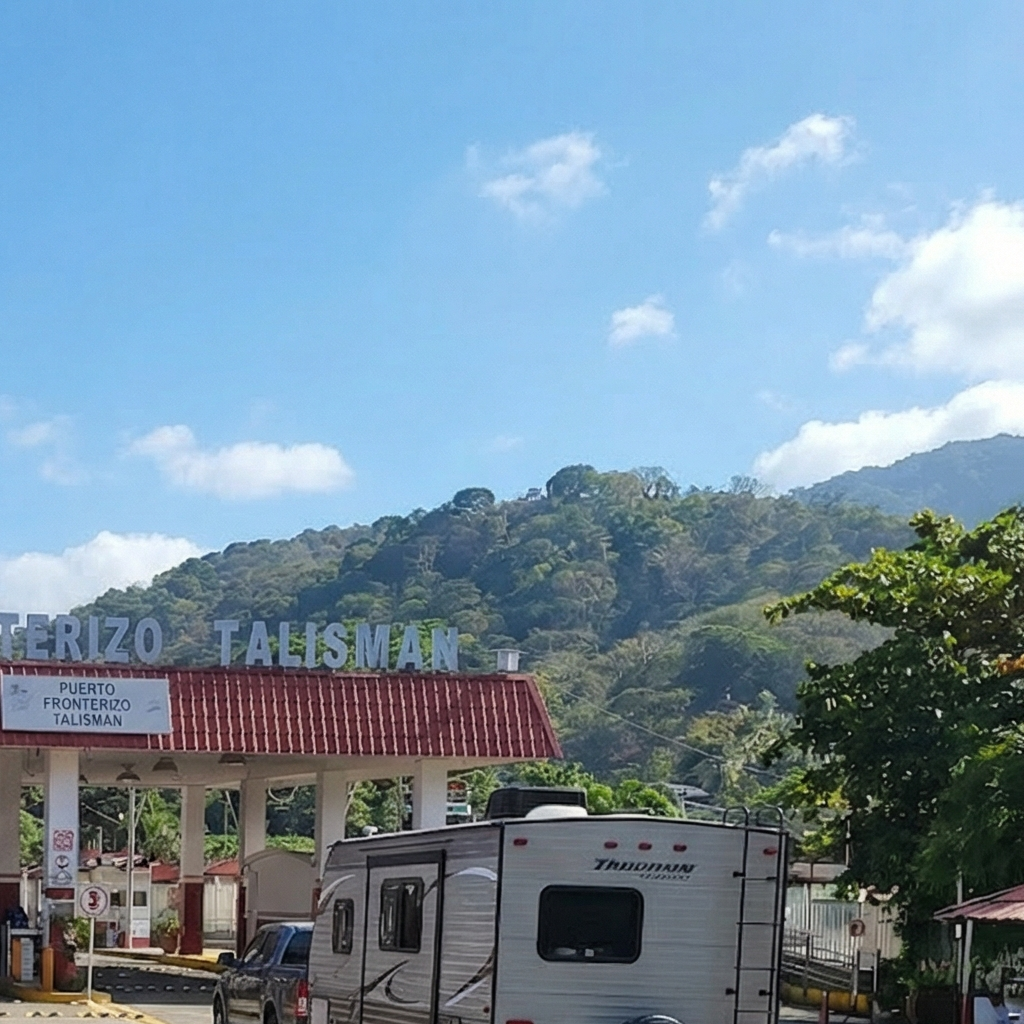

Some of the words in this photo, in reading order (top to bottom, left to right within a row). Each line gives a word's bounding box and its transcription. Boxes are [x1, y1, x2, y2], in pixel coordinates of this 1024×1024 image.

[214, 620, 458, 670] TALISMAN
[59, 682, 115, 695] PUERTO
[44, 698, 131, 711] FRONTERIZO
[53, 713, 122, 726] TALISMAN
